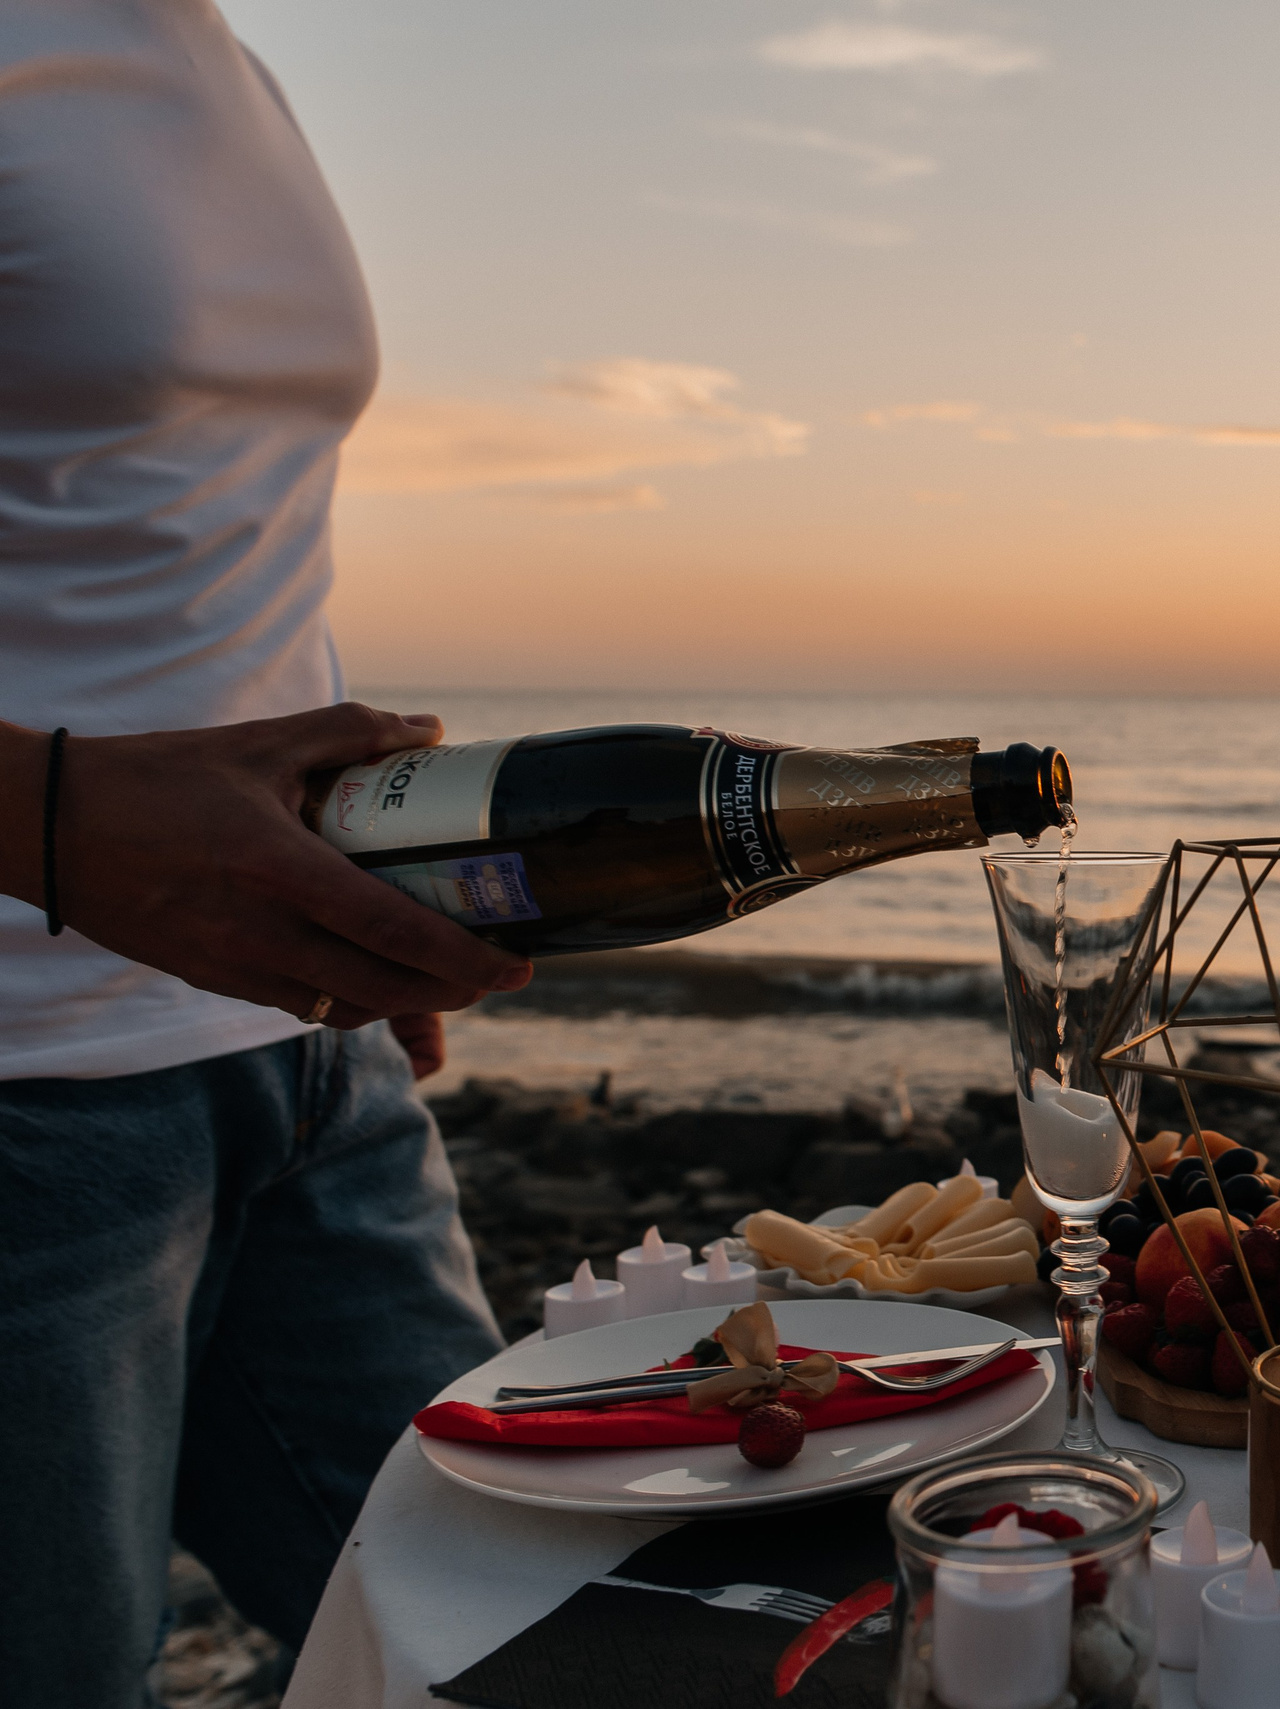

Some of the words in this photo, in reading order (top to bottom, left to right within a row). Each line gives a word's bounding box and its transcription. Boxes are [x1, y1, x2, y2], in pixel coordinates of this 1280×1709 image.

[815, 754, 876, 794] ДЗИВ
[720, 791, 739, 840] БЕЛОЕ
[734, 754, 772, 875] ДЕРБЕНТСКОЕ
